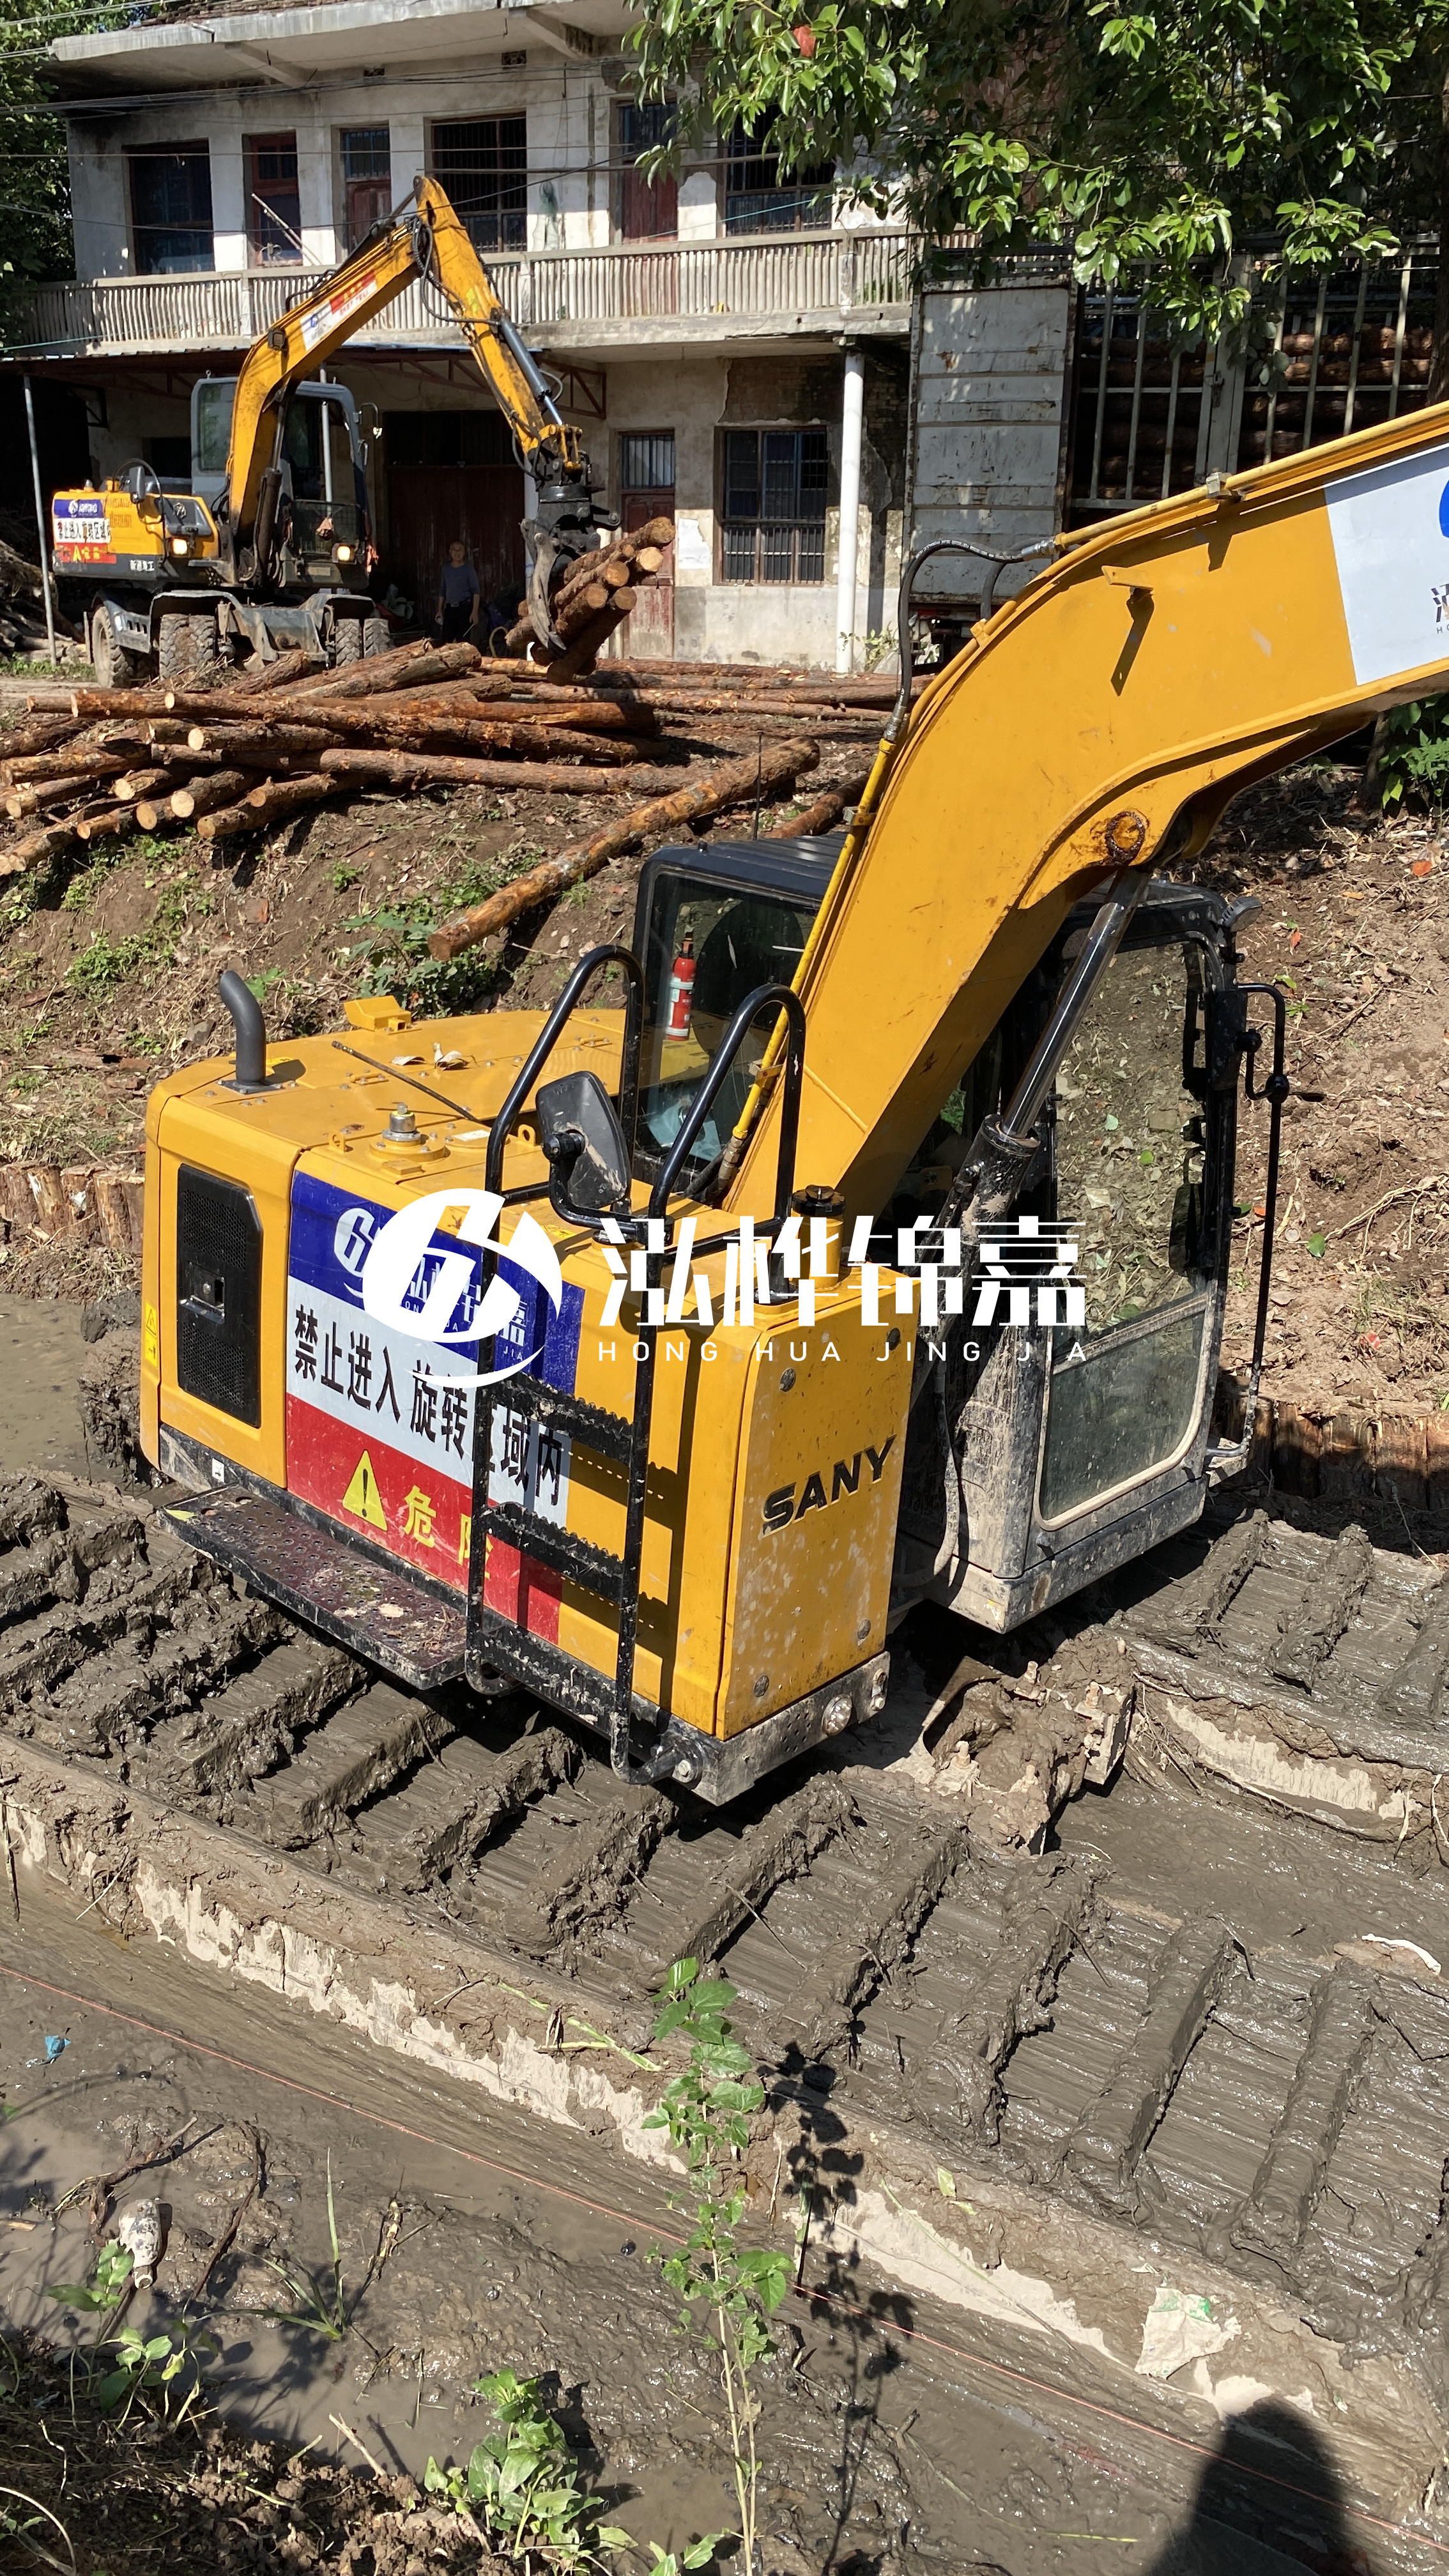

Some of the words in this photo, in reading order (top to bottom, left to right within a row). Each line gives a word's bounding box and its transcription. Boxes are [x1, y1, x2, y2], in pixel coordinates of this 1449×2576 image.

[294, 1303, 563, 1506] 禁止进入旋转域内
[503, 1346, 524, 1361] JIA
[761, 1434, 898, 1539] SANY
